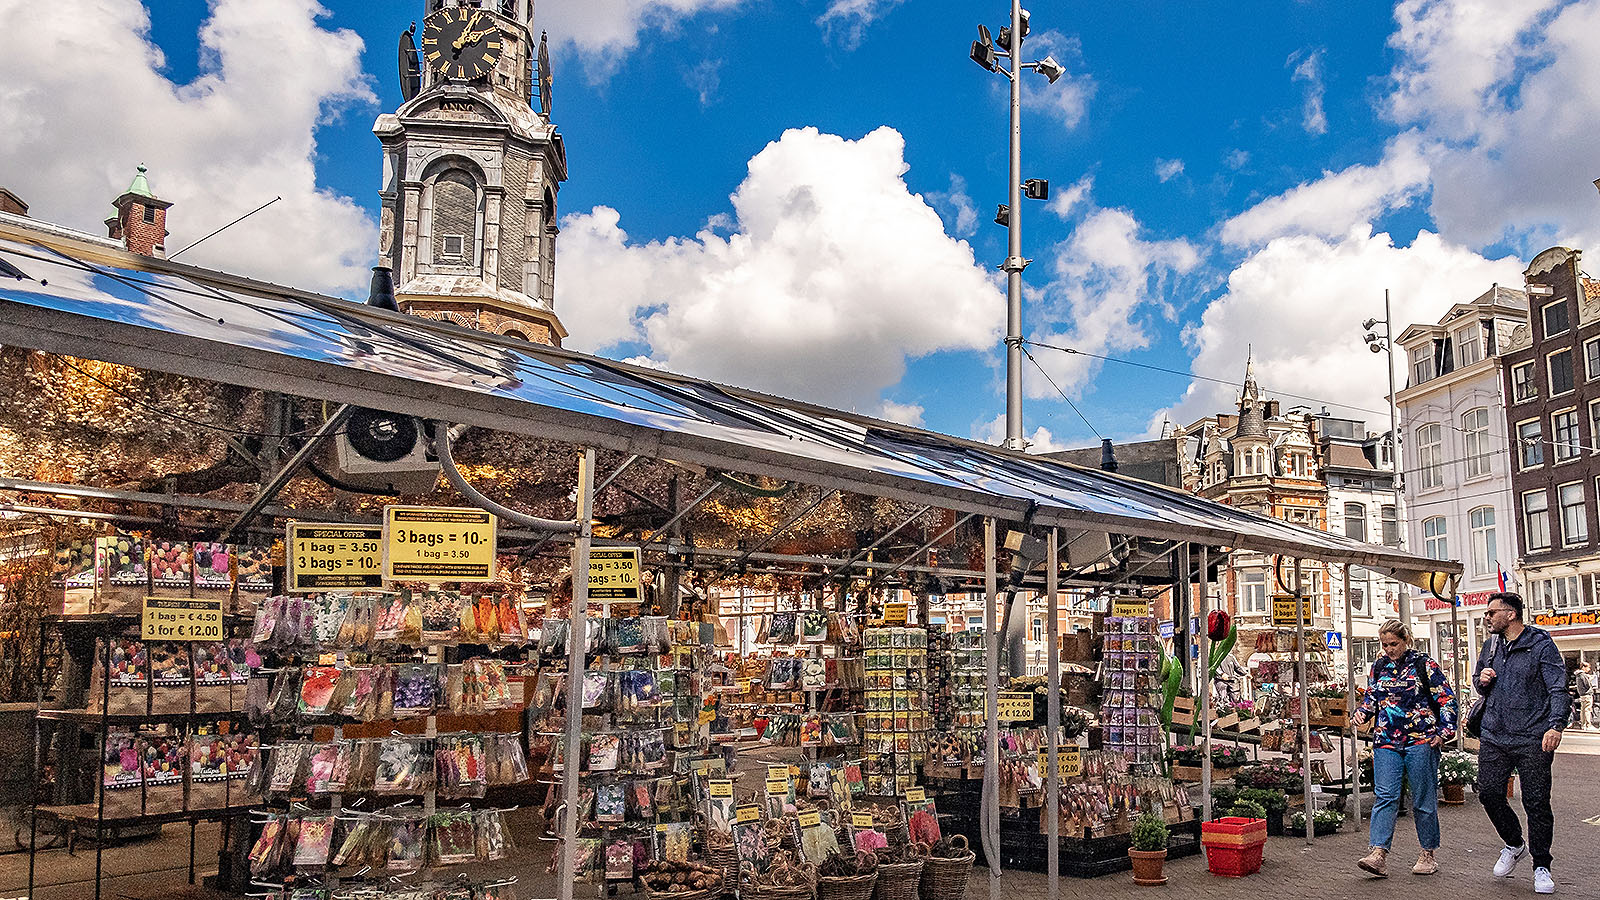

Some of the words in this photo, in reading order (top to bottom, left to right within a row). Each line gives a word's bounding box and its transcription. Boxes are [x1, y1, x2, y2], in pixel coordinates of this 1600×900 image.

[442, 102, 474, 112] ANNO
[397, 530, 406, 542] 3
[410, 530, 444, 546] bags
[462, 532, 488, 544] 10.-
[299, 542, 305, 552] 1
[311, 542, 334, 554] bag
[351, 542, 378, 552] 3.50
[424, 550, 440, 560] bag
[451, 550, 470, 558] 3.50
[298, 556, 306, 568] 3
[311, 556, 342, 571] bags
[358, 556, 380, 568] 10.-
[614, 562, 633, 570] 3.50
[158, 612, 176, 622] bag
[1536, 615, 1570, 626] Chipsy
[1571, 613, 1596, 624] King
[148, 624, 155, 635] 3
[158, 625, 174, 635] for
[178, 625, 185, 635] €
[188, 626, 218, 636] 12.00
[1061, 764, 1078, 772] 12.00
